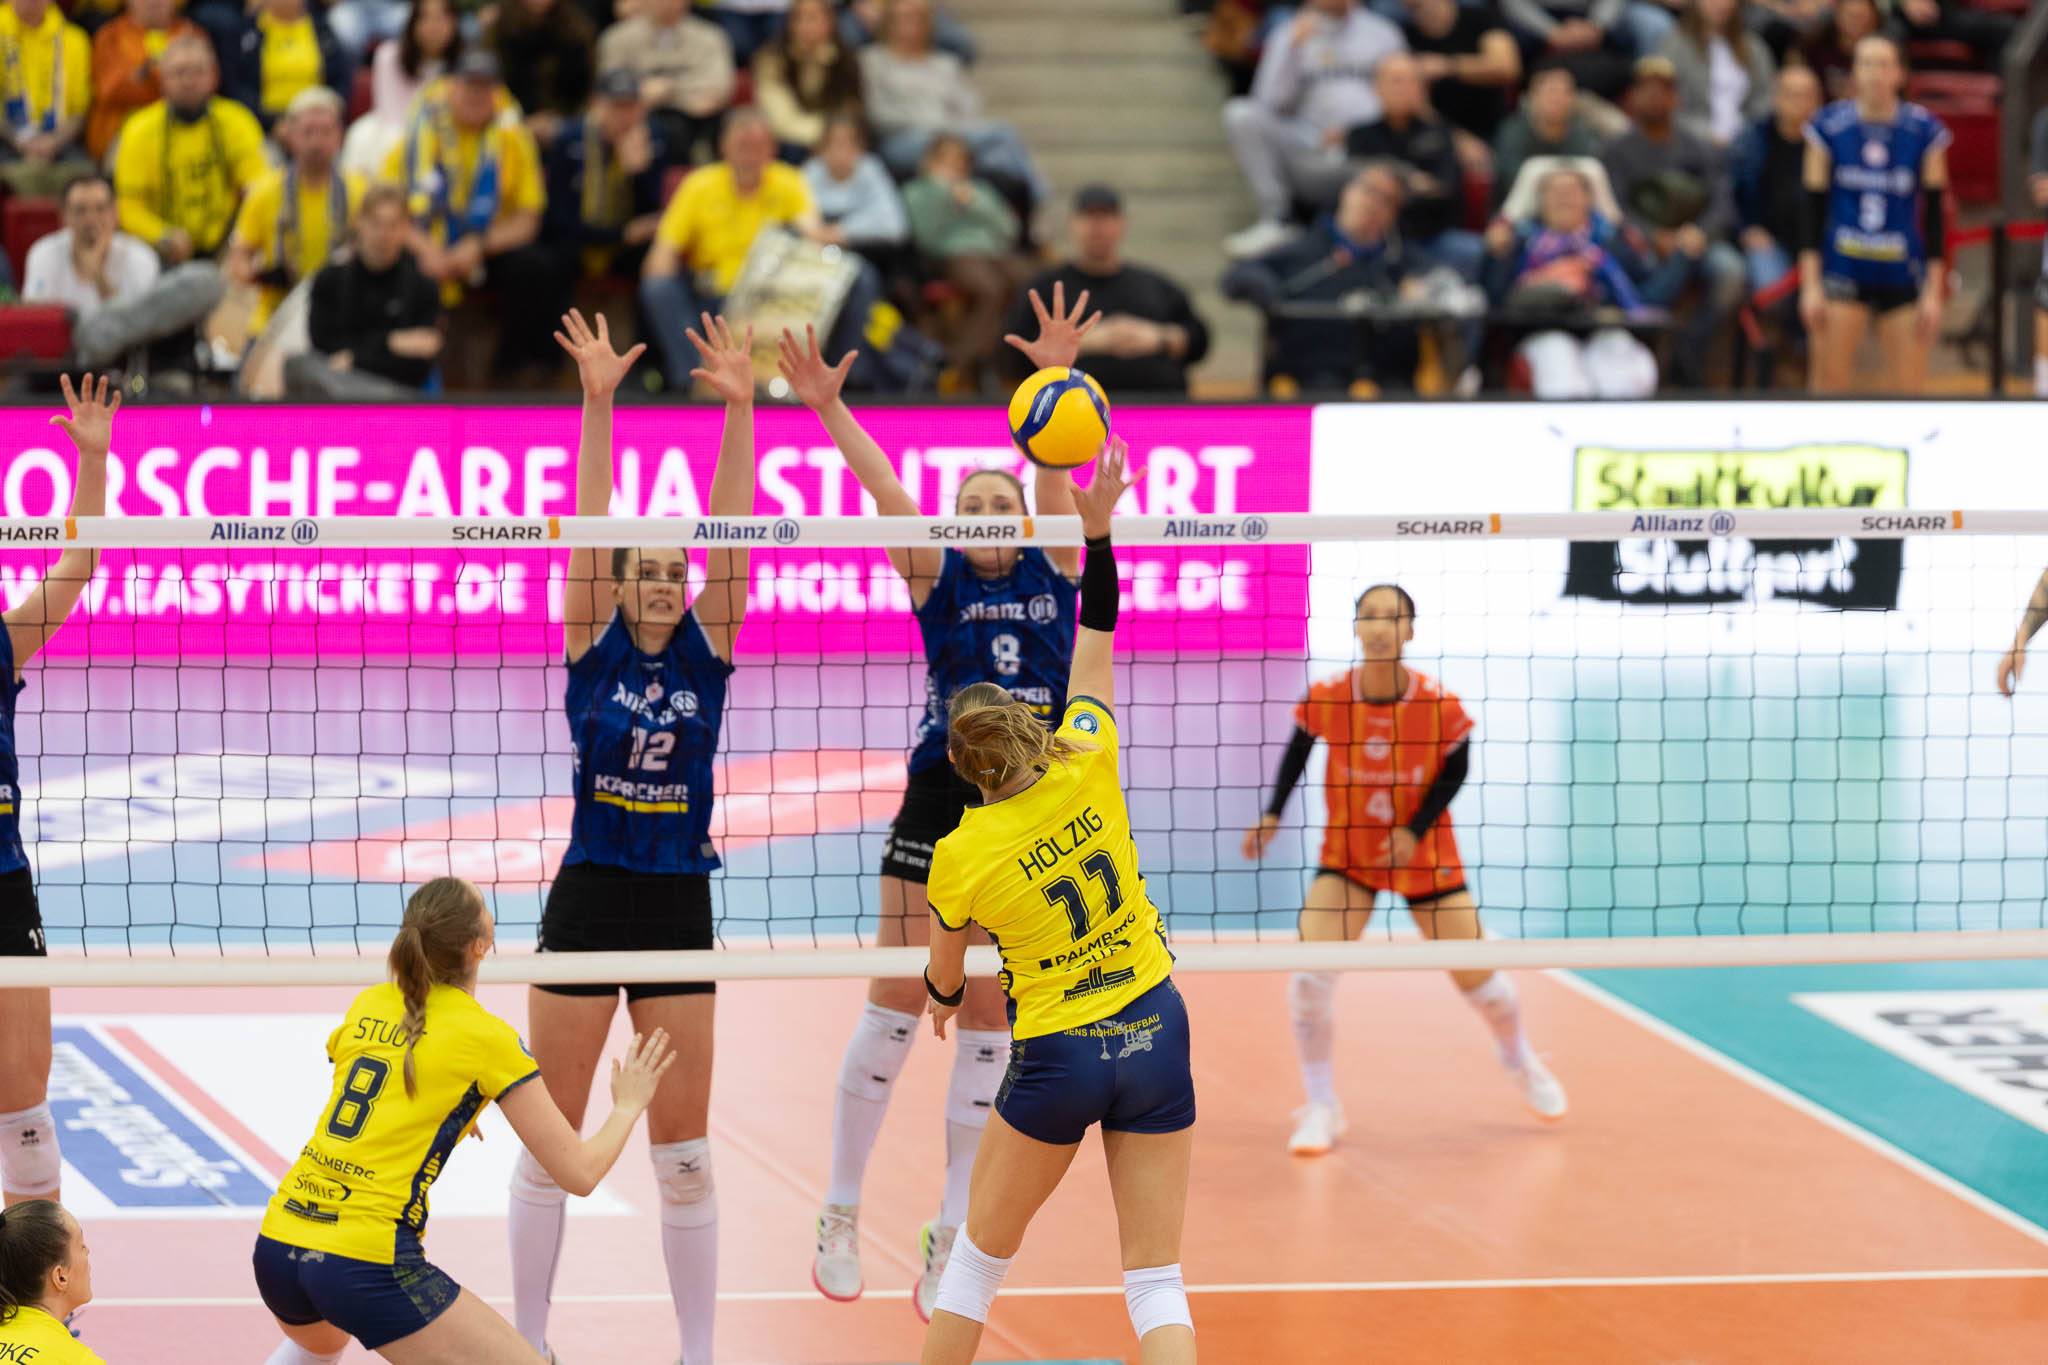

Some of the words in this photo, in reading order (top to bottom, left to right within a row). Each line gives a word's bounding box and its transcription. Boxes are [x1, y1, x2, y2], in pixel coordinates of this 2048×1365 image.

[210, 522, 286, 541] Allianz
[693, 522, 768, 541] Allianz
[929, 525, 1017, 540] SCHARR
[1163, 519, 1236, 538] Allianz
[1396, 520, 1484, 535] SCHARR
[1631, 514, 1704, 533] Allianz
[1861, 516, 1947, 531] SCHARR
[452, 526, 543, 541] SCHARR
[991, 633, 1021, 675] 8
[628, 726, 676, 772] 12
[1364, 790, 1394, 824] 4
[1017, 805, 1104, 881] HÖLZIG
[1040, 848, 1124, 944] 11
[1103, 976, 1137, 992] SCHWERIN
[1064, 1026, 1088, 1037] JENS
[1089, 1025, 1124, 1038] ROHDE
[1124, 1011, 1161, 1032] TIEFBAU
[326, 1051, 393, 1143] 8
[306, 1146, 376, 1181] PALMBERG
